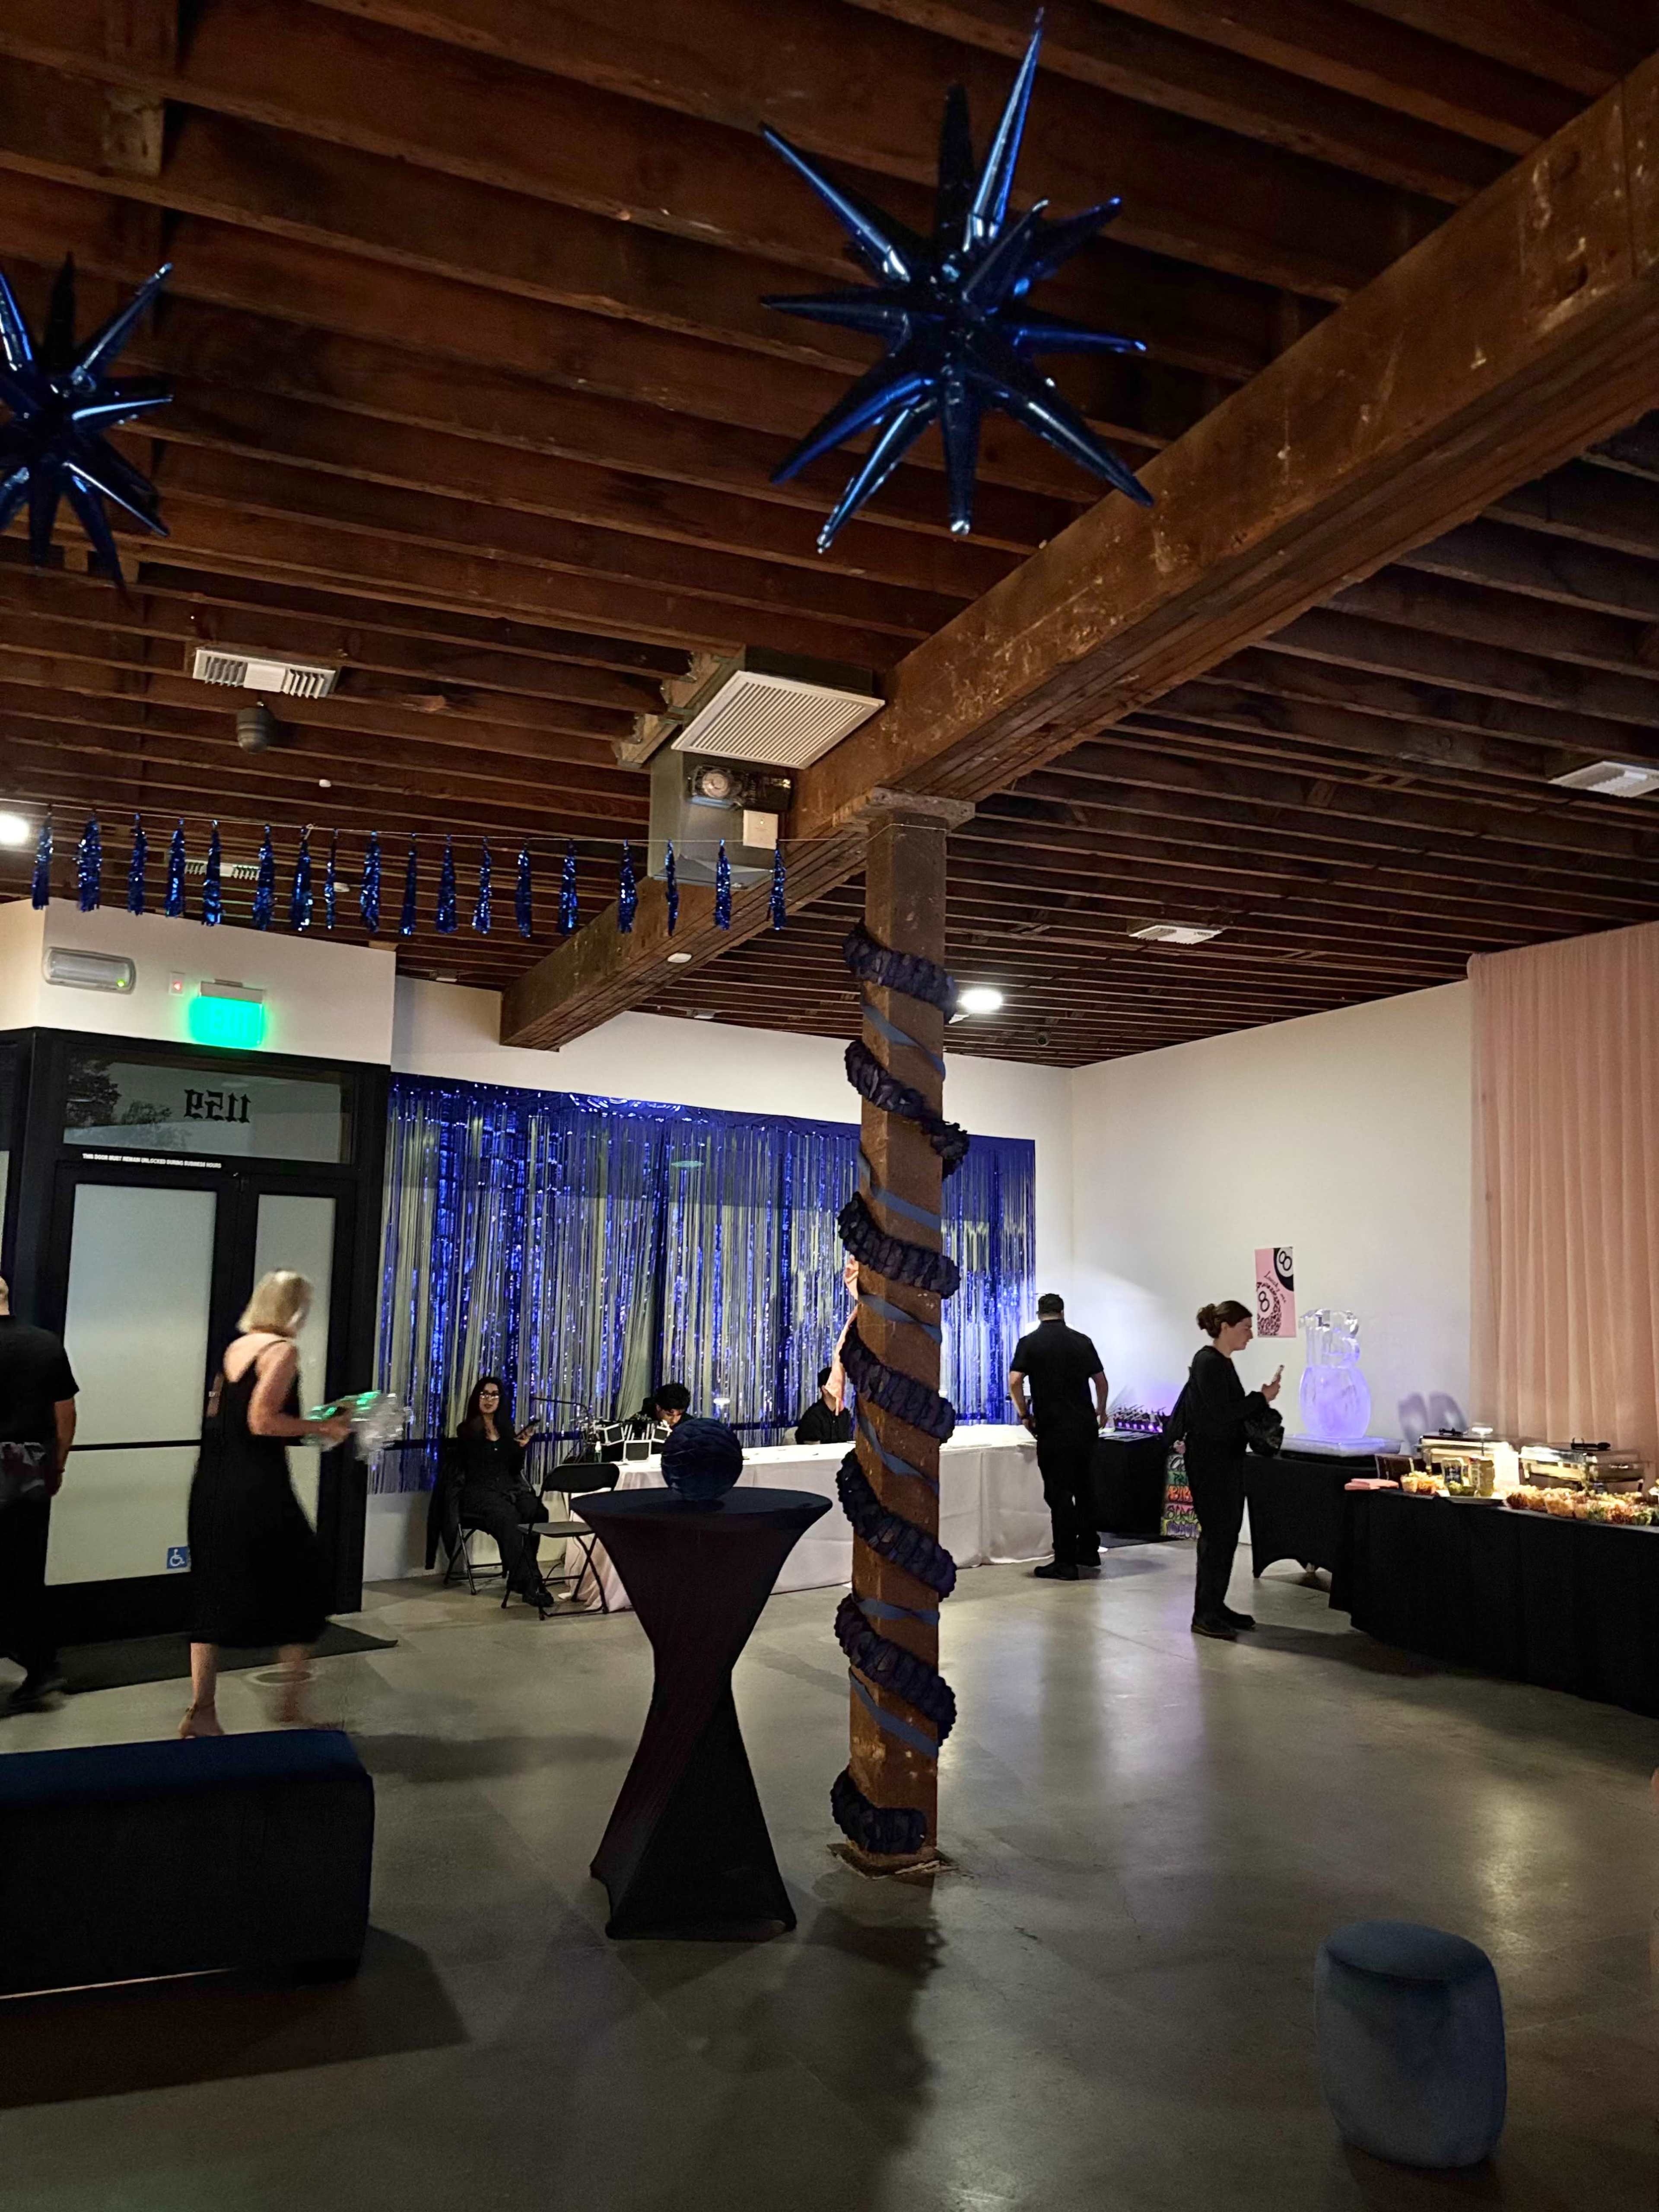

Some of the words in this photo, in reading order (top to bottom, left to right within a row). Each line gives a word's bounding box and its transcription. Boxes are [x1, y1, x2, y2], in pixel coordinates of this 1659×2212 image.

[209, 1004, 253, 1038] EXIT
[1279, 1251, 1292, 1271] 8
[1258, 1291, 1270, 1313] 8
